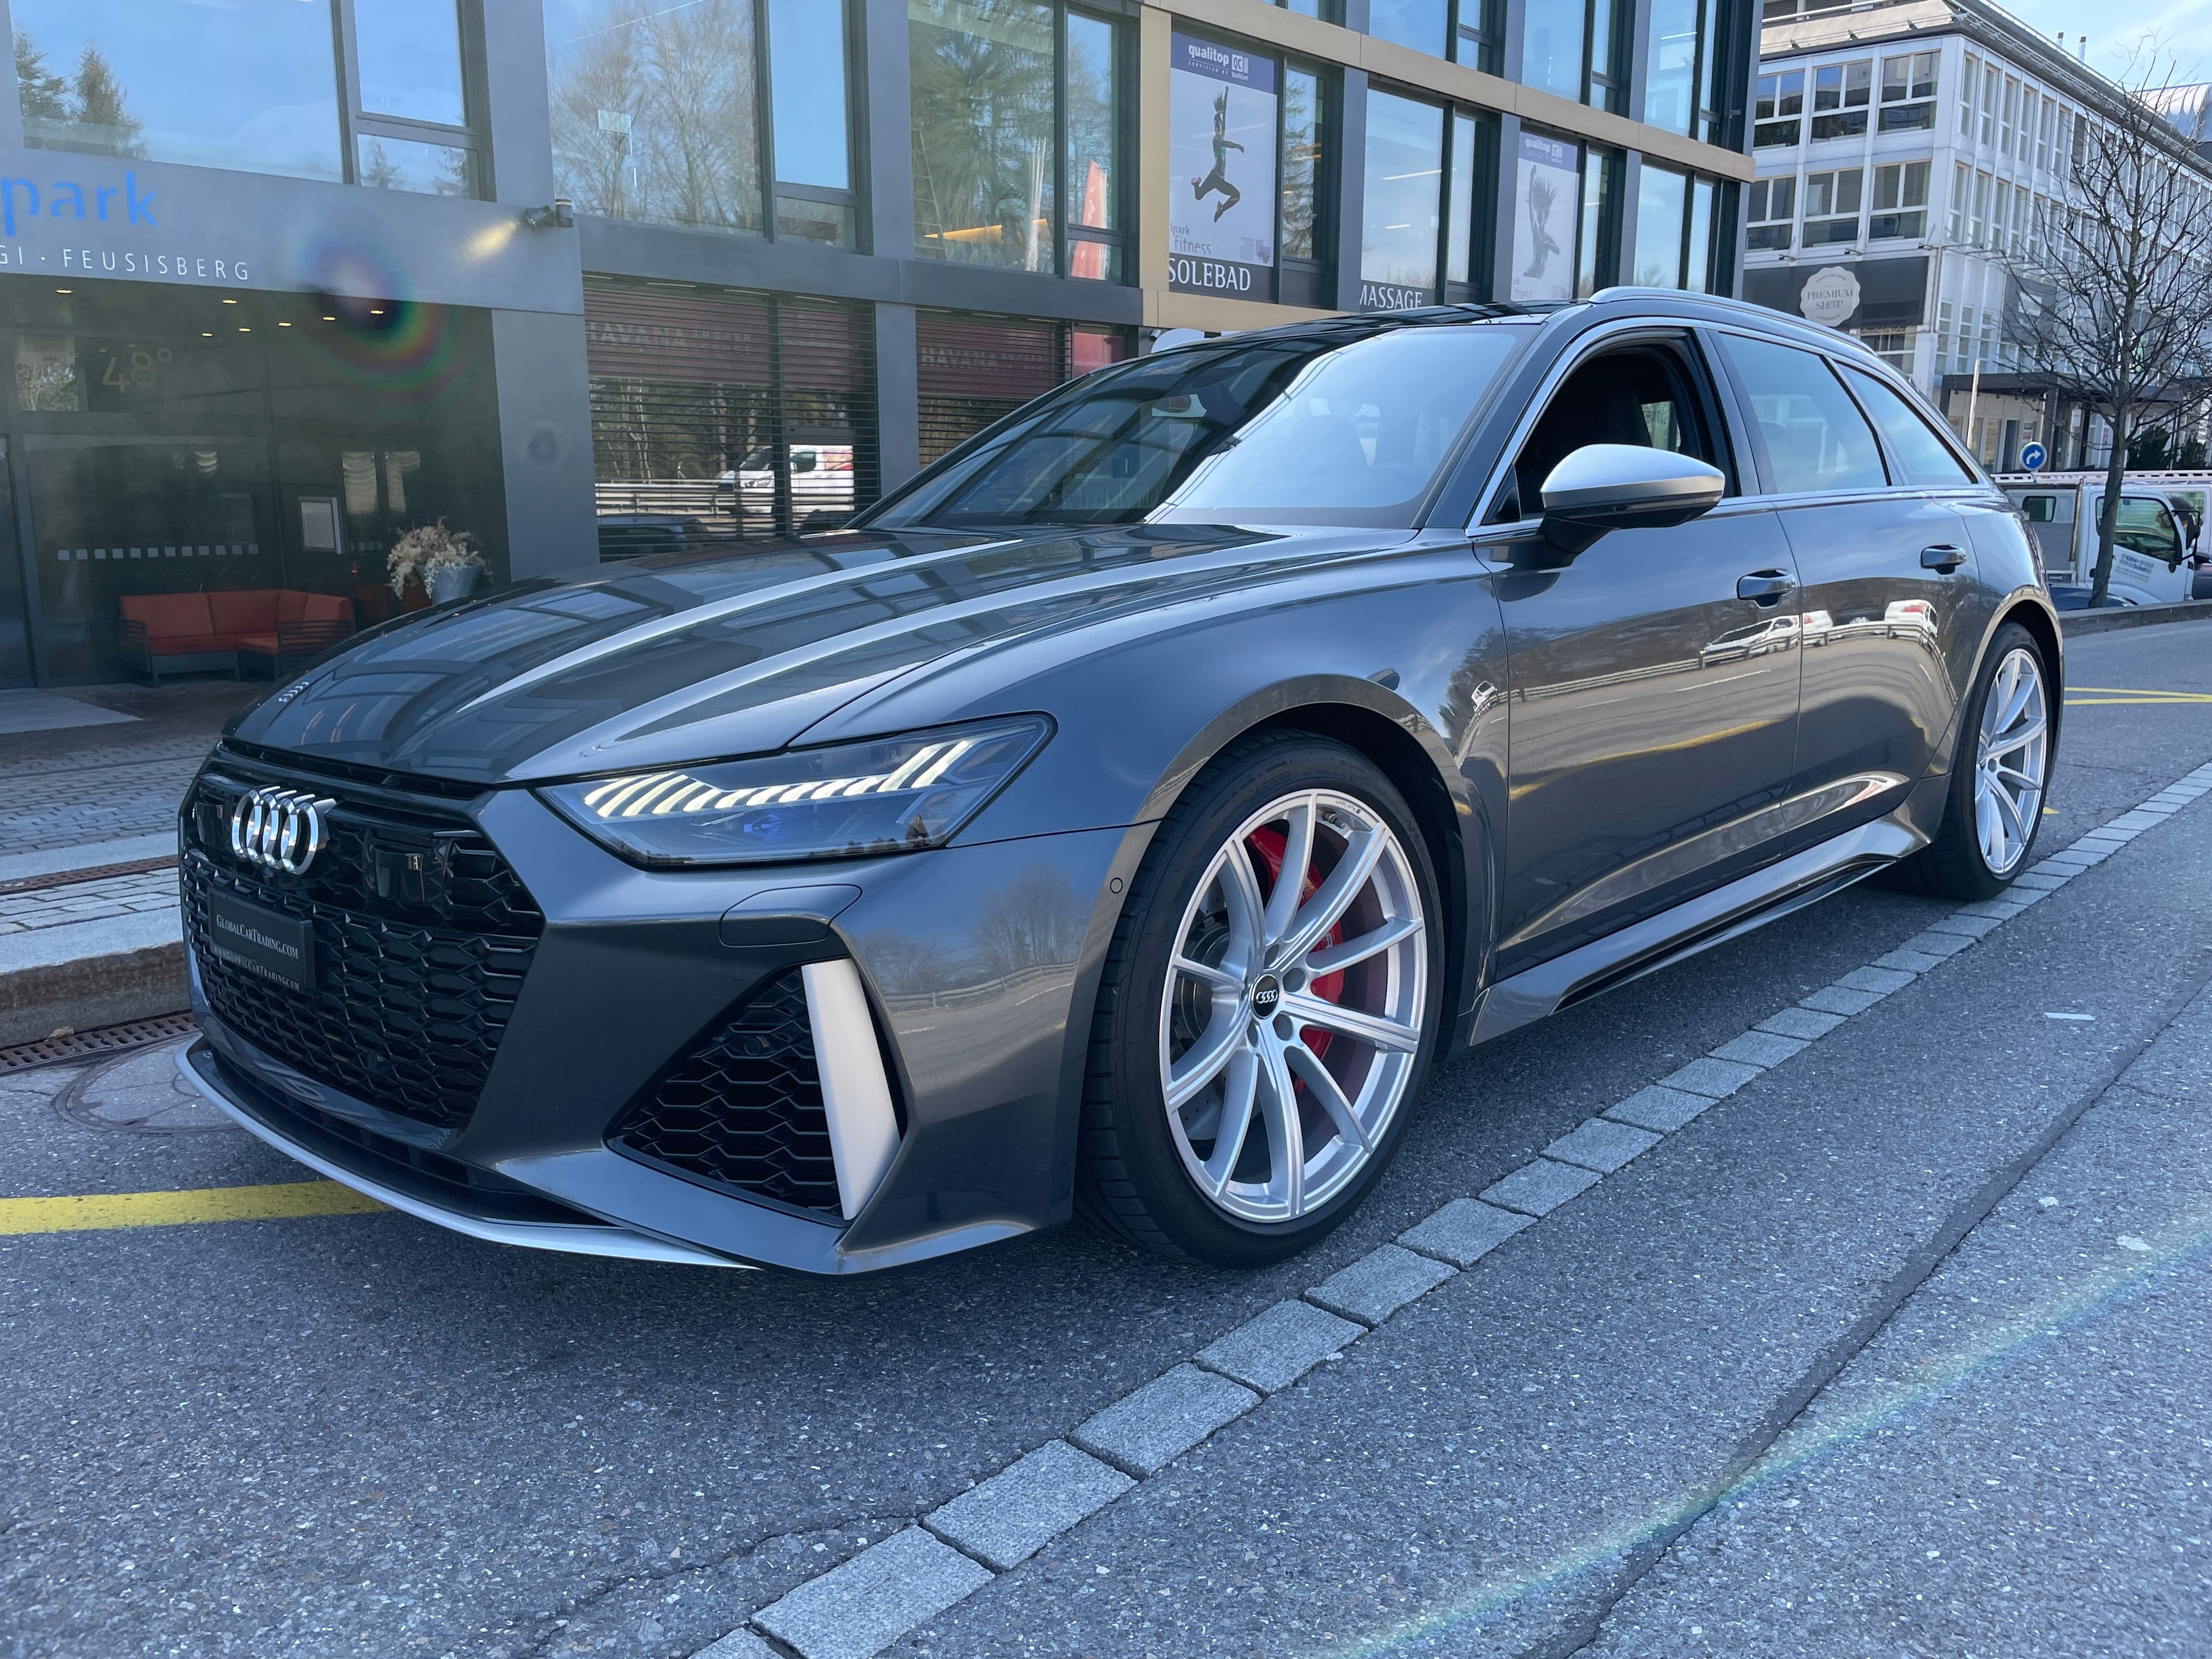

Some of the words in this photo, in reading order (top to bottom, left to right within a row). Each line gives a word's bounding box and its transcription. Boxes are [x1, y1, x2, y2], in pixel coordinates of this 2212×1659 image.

[1188, 45, 1229, 67] qualitop
[1525, 138, 1551, 154] qualitop
[1, 171, 158, 236] park
[1175, 235, 1212, 255] fitness
[63, 249, 248, 280] FEUSISBERG
[1169, 257, 1251, 291] SOLEBAD
[1807, 289, 1853, 300] PREMIUM
[692, 329, 751, 342] SMOKER
[922, 347, 999, 370] HAVANA
